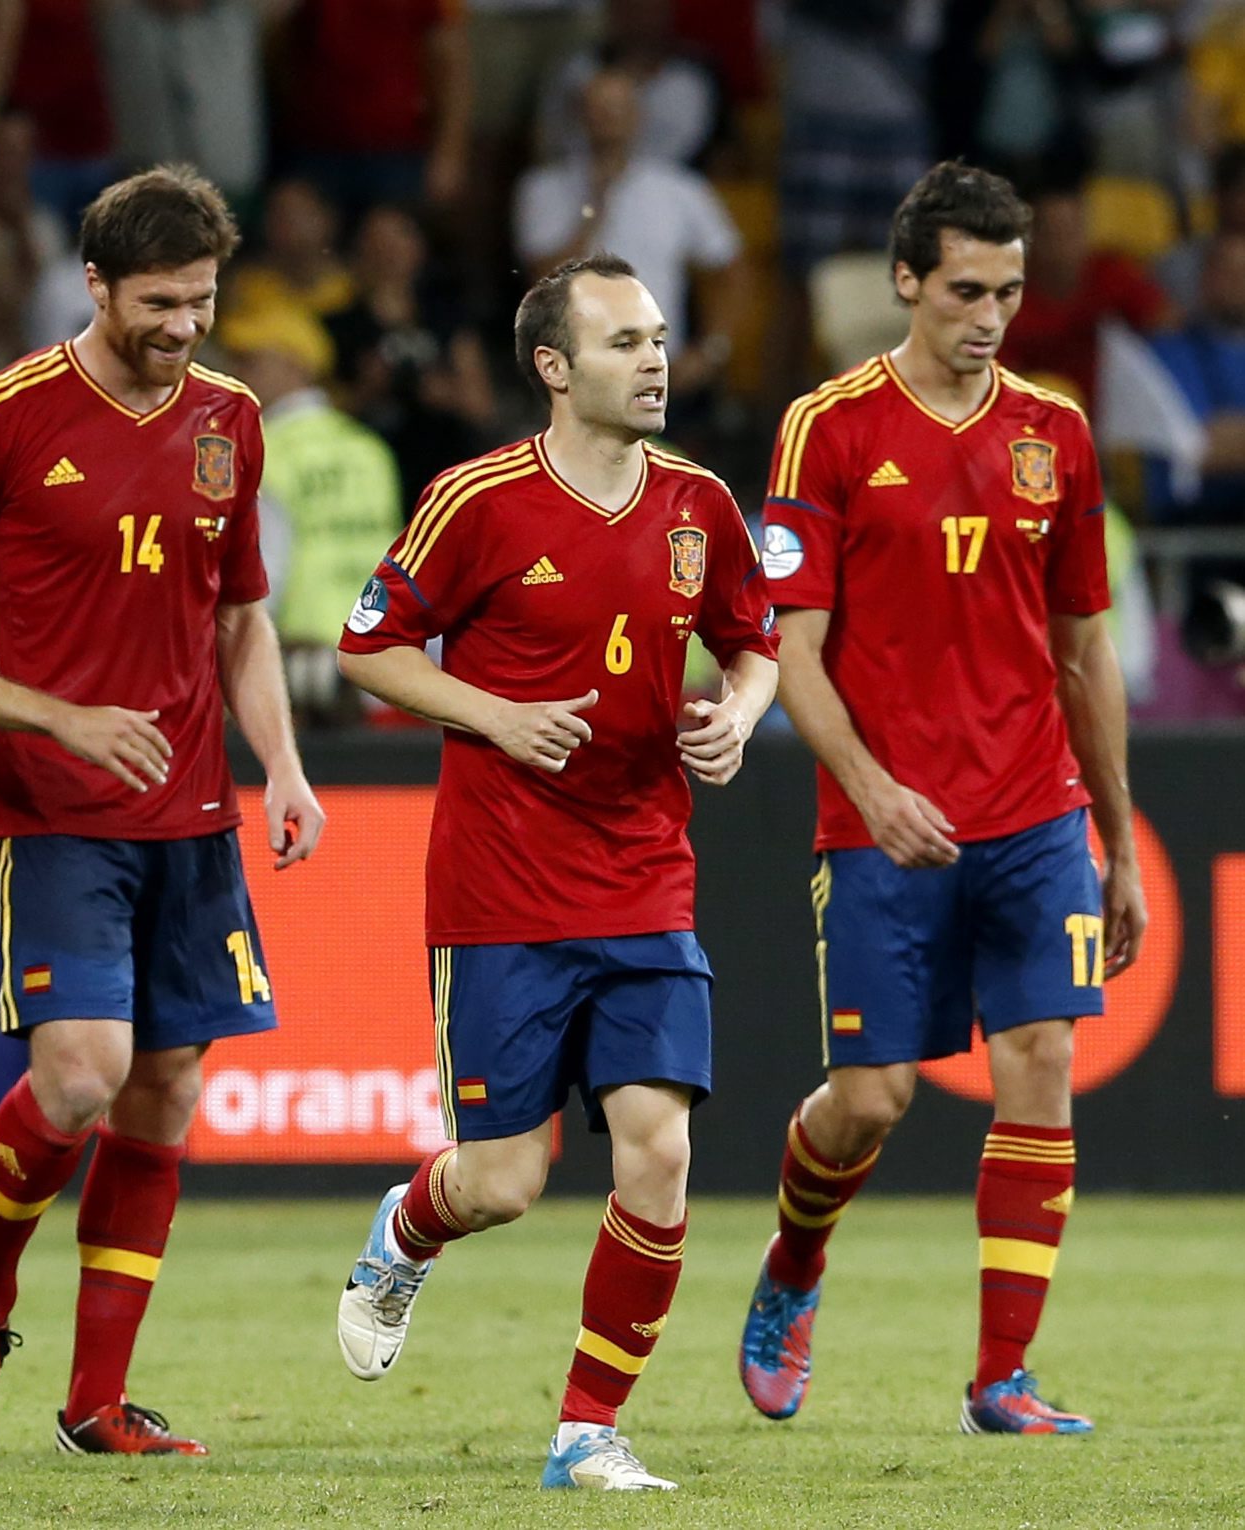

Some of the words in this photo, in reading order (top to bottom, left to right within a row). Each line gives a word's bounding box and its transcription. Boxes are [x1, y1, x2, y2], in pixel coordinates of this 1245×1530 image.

[43, 472, 85, 487] adidas
[118, 514, 164, 573] 14
[941, 516, 989, 573] 17
[522, 572, 564, 585] adidas
[605, 614, 632, 675] 6
[226, 930, 272, 1005] 14
[1064, 913, 1104, 988] 17
[204, 1068, 457, 1154] orang
